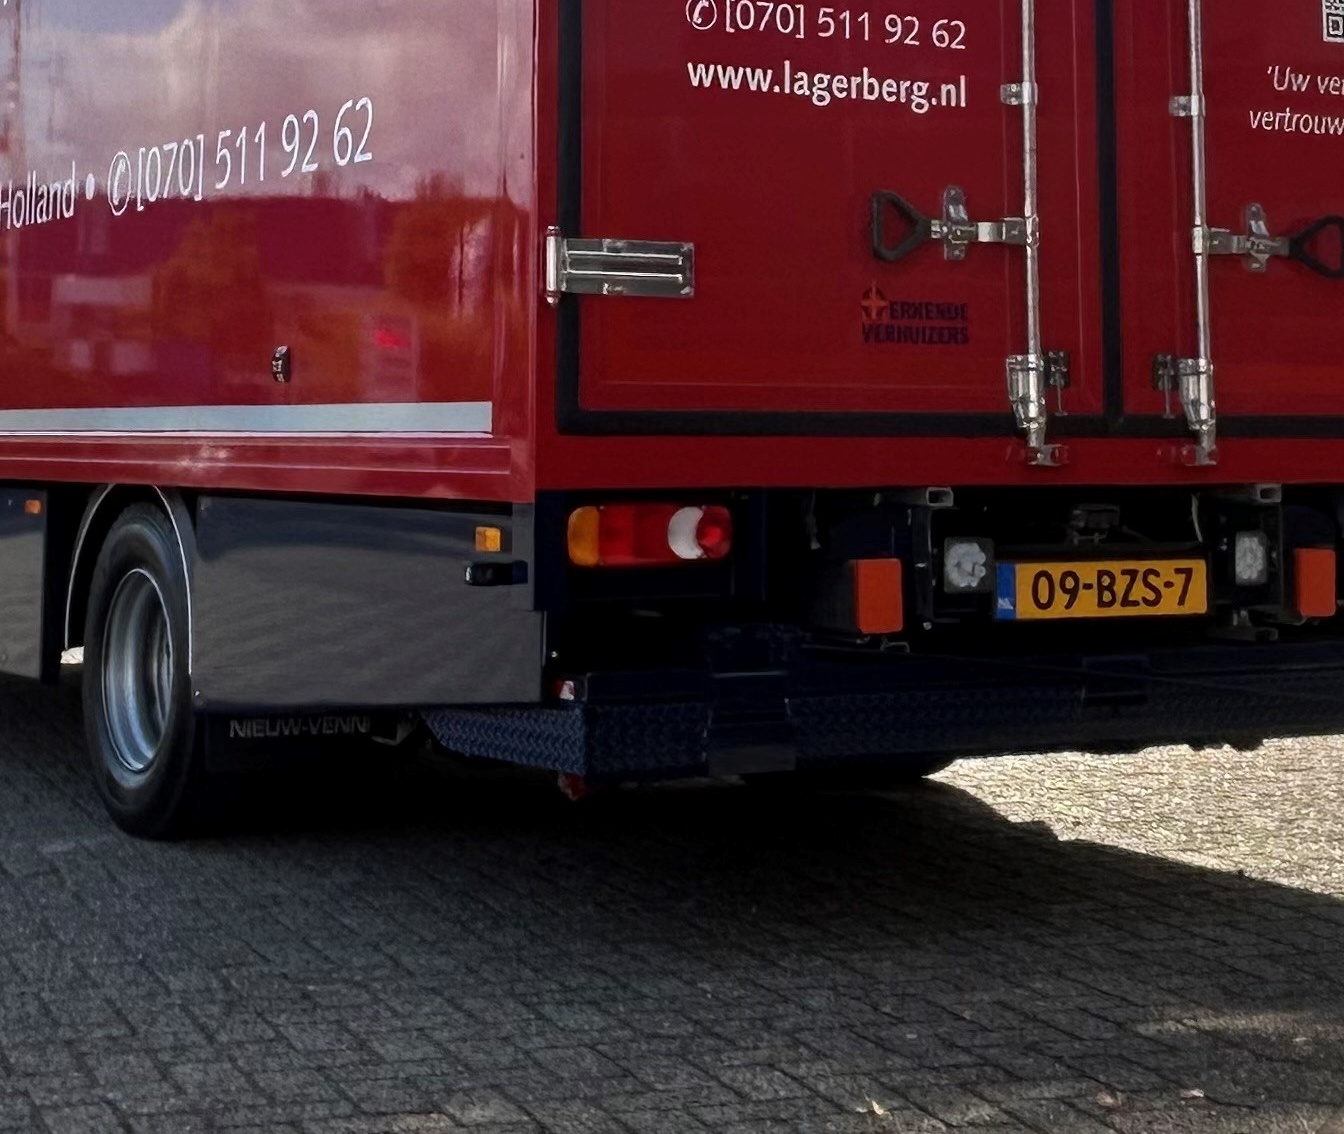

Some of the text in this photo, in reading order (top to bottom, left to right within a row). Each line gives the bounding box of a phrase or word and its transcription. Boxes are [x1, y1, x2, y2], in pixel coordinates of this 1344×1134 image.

[817, 7, 870, 42] 511
[884, 13, 920, 46] 92
[932, 18, 966, 50] 62
[686, 59, 967, 114] www.lagerberg.nl
[136, 133, 205, 213] [070]
[215, 121, 267, 191] 511
[280, 109, 320, 178] 92
[332, 96, 374, 166] 62
[1031, 567, 1194, 611] 09-BZS-7
